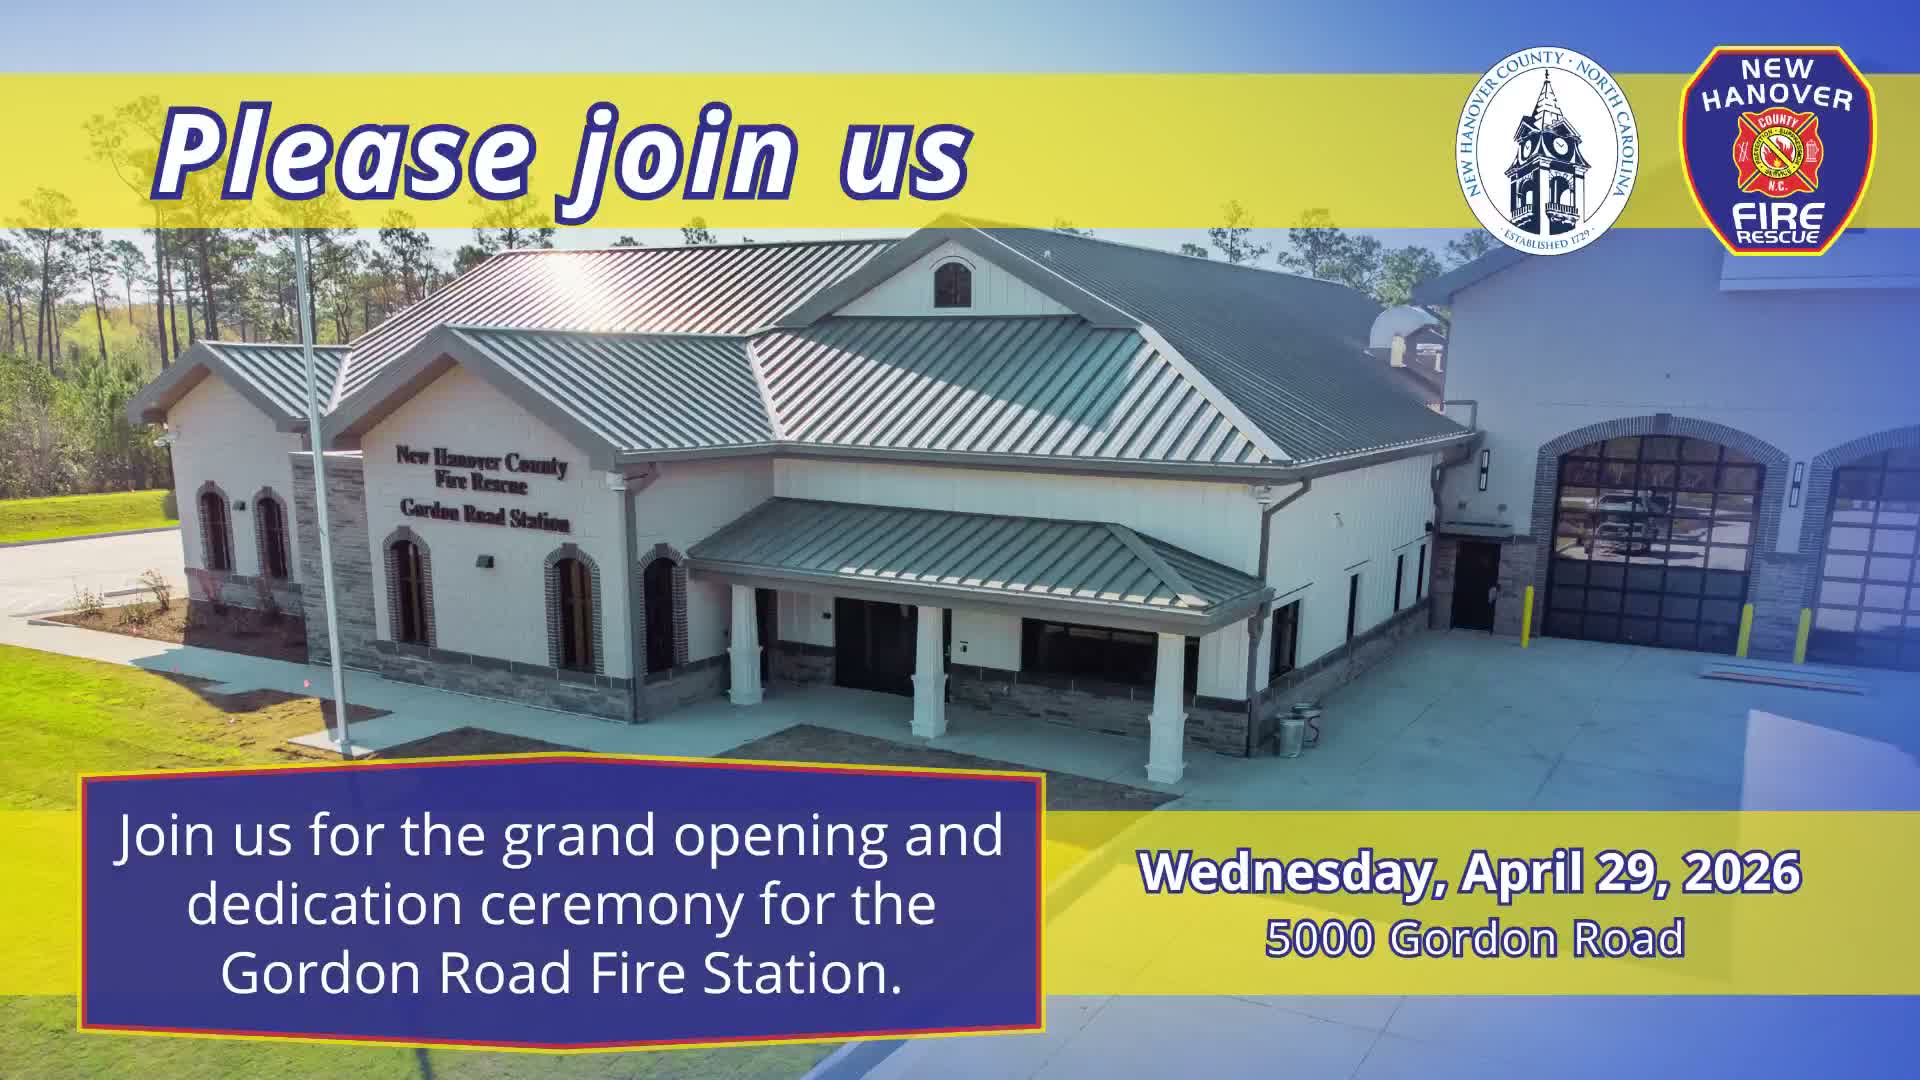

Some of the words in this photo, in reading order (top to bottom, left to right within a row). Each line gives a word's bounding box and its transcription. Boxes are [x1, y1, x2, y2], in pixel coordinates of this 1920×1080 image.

[396, 444, 430, 465] New
[433, 447, 502, 471] Hanover
[505, 452, 568, 480] County
[434, 469, 467, 489] Fire
[470, 472, 528, 495] Rescue
[400, 498, 459, 521] Gordon
[463, 504, 506, 525] Road
[510, 508, 570, 533] Station
